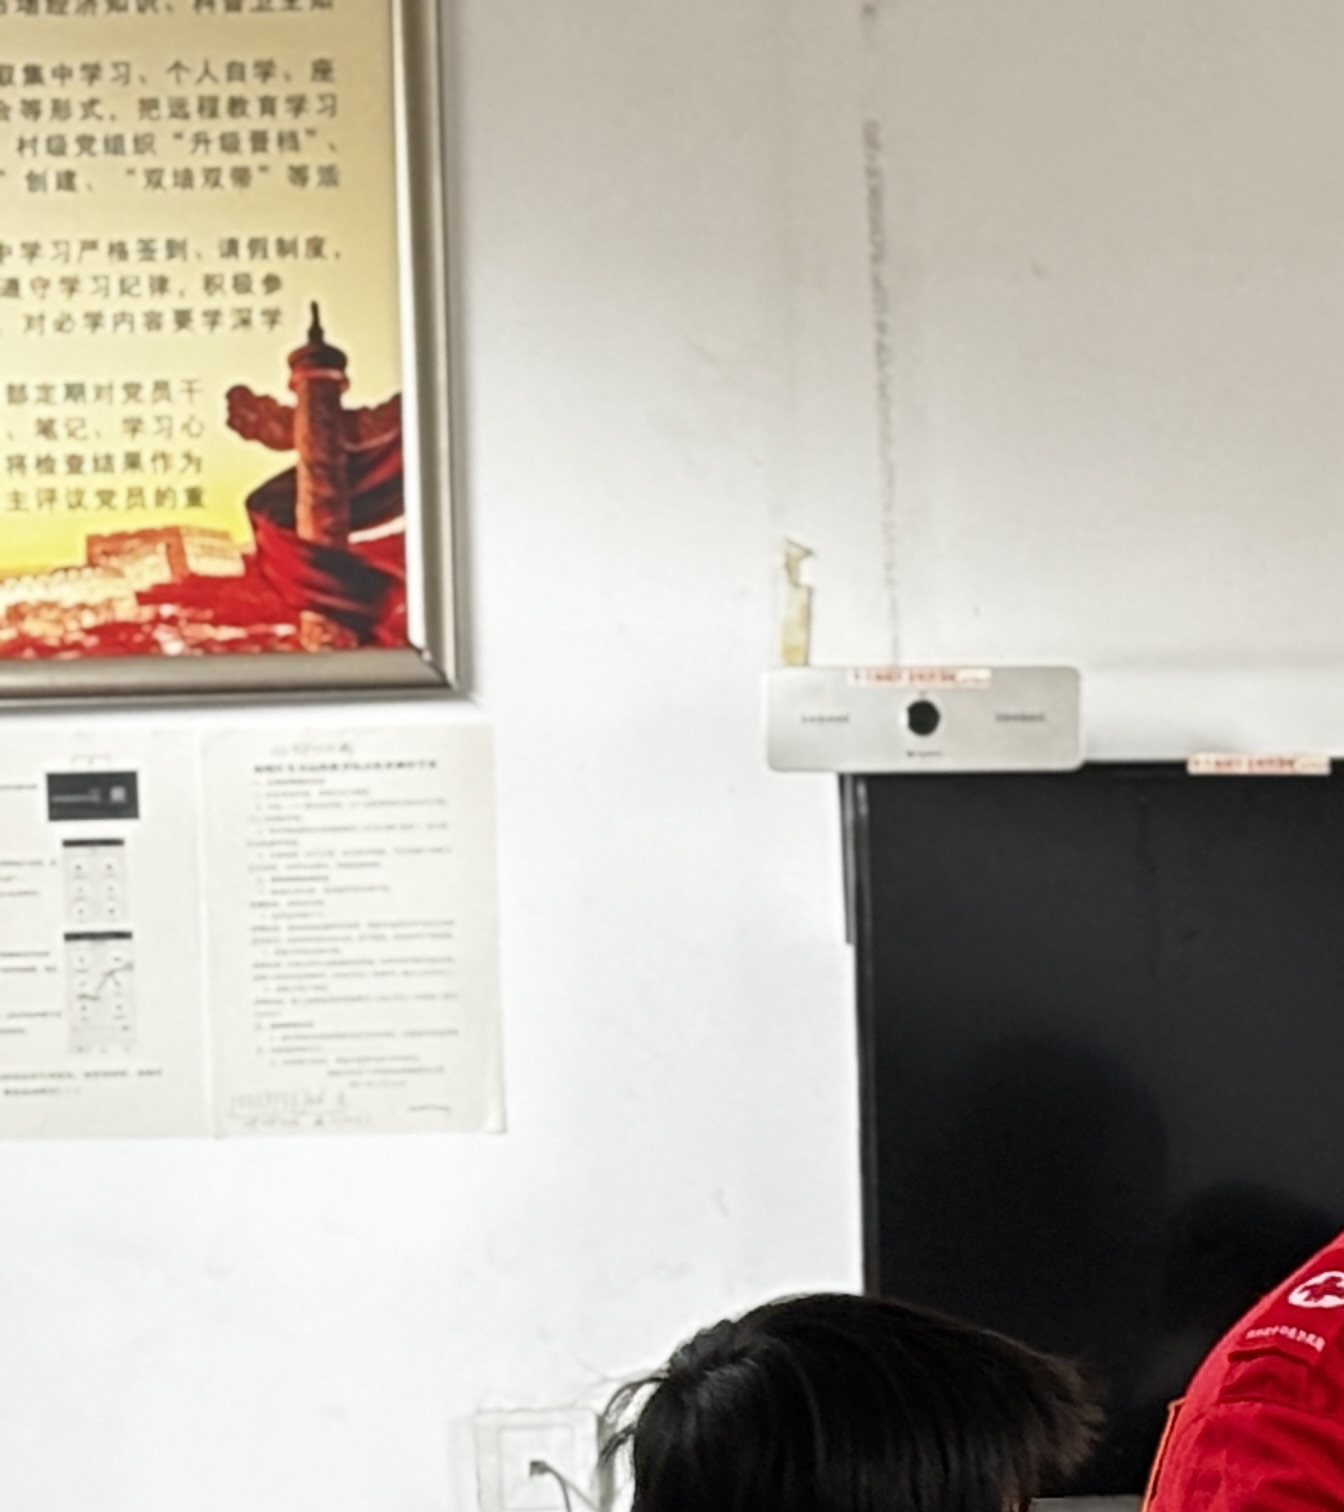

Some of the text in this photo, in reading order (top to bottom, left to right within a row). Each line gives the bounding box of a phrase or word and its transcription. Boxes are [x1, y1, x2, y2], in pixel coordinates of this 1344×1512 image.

[7, 379, 204, 405] 部定期对党员干
[6, 451, 203, 478] 将检查结果作为
[7, 486, 207, 512] 主评议党员的重
